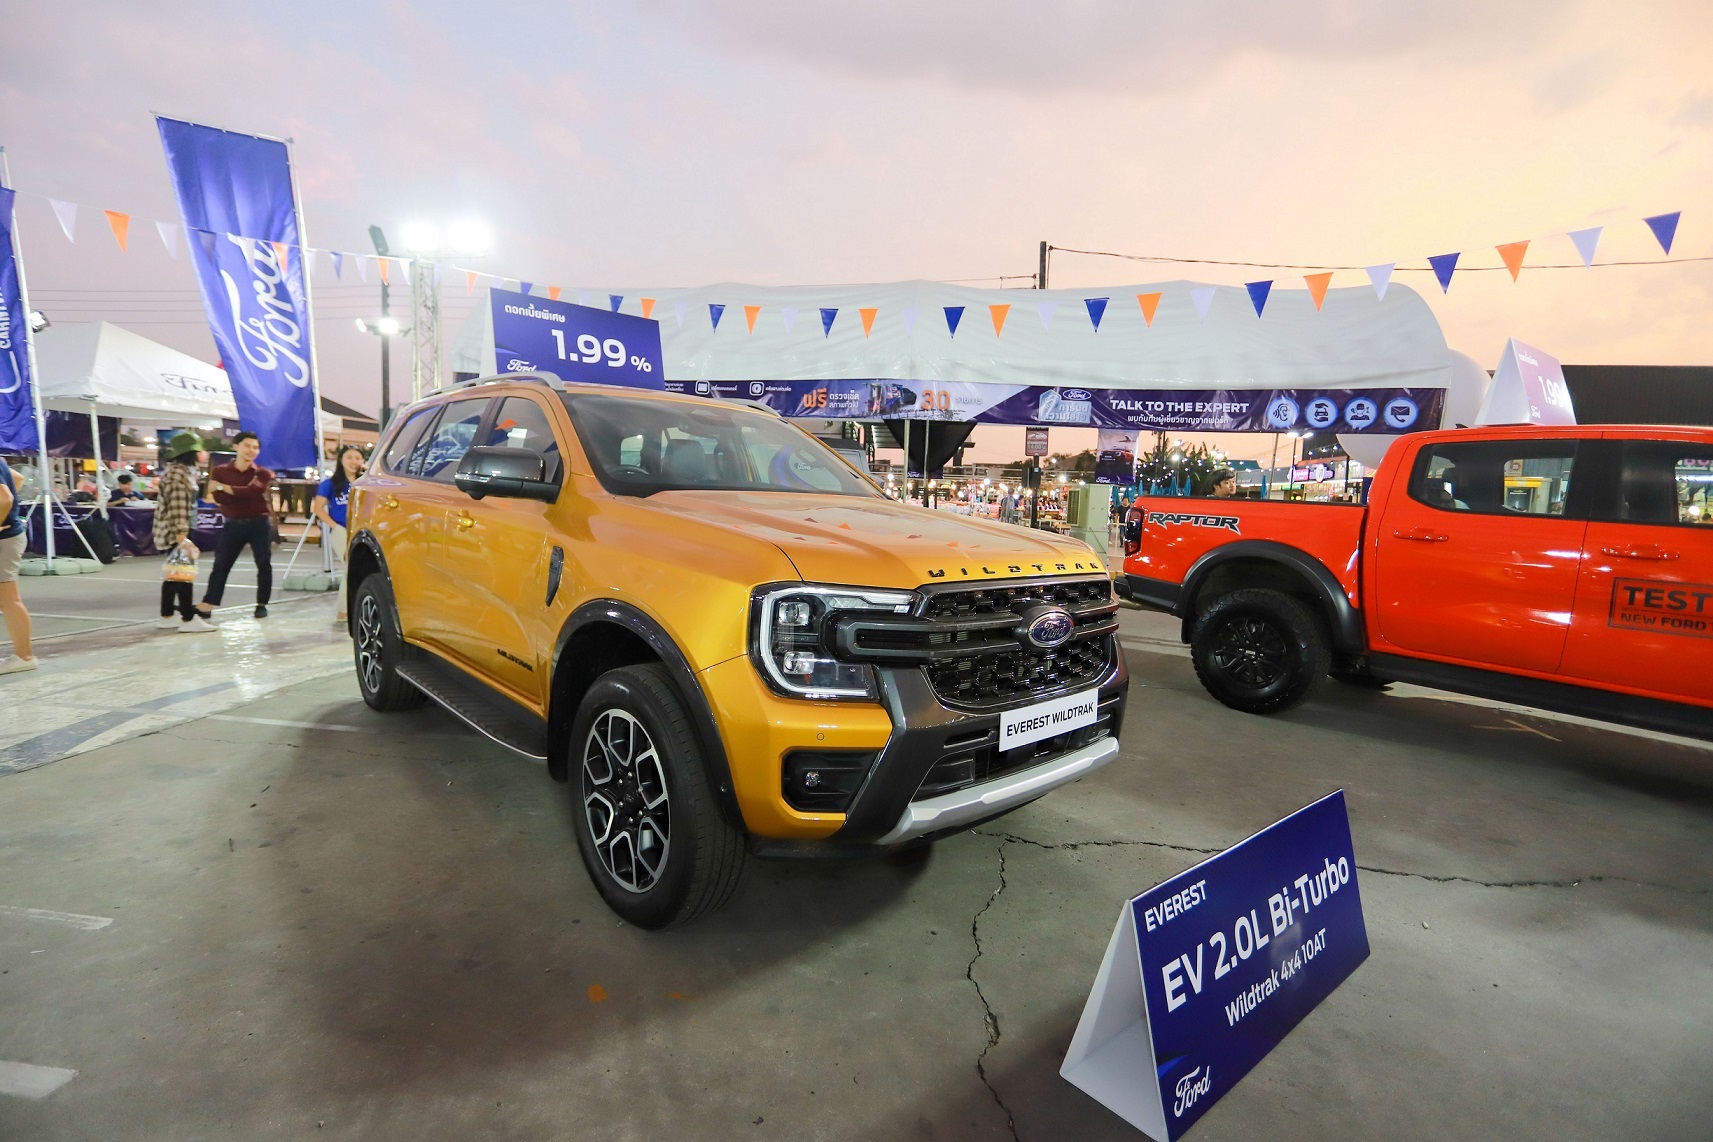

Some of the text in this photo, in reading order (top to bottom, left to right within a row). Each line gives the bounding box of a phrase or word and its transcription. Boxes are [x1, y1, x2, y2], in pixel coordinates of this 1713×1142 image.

[504, 303, 567, 324] ดอกเบี้ยพิเศษ
[551, 328, 652, 373] 1.99 %
[506, 358, 537, 372] Ford
[802, 387, 828, 409] ฟรี
[829, 390, 860, 401] ตรวจเช็ค
[1109, 399, 1250, 413] TALK TO THE EXPERT
[1148, 511, 1241, 536] RAPTOR
[927, 562, 1099, 578] WILDTRAK
[1623, 585, 1713, 613] TEST
[1620, 612, 1707, 631] NEW FORD
[1006, 702, 1094, 737] EVEREST WILDTRAK
[1144, 879, 1207, 933] EVEREST
[1161, 855, 1350, 1014] EV 2.0L Bi-Turbo
[1224, 927, 1327, 1028] Wildtrak 4x4 10AT
[1173, 1064, 1212, 1118] Ford
